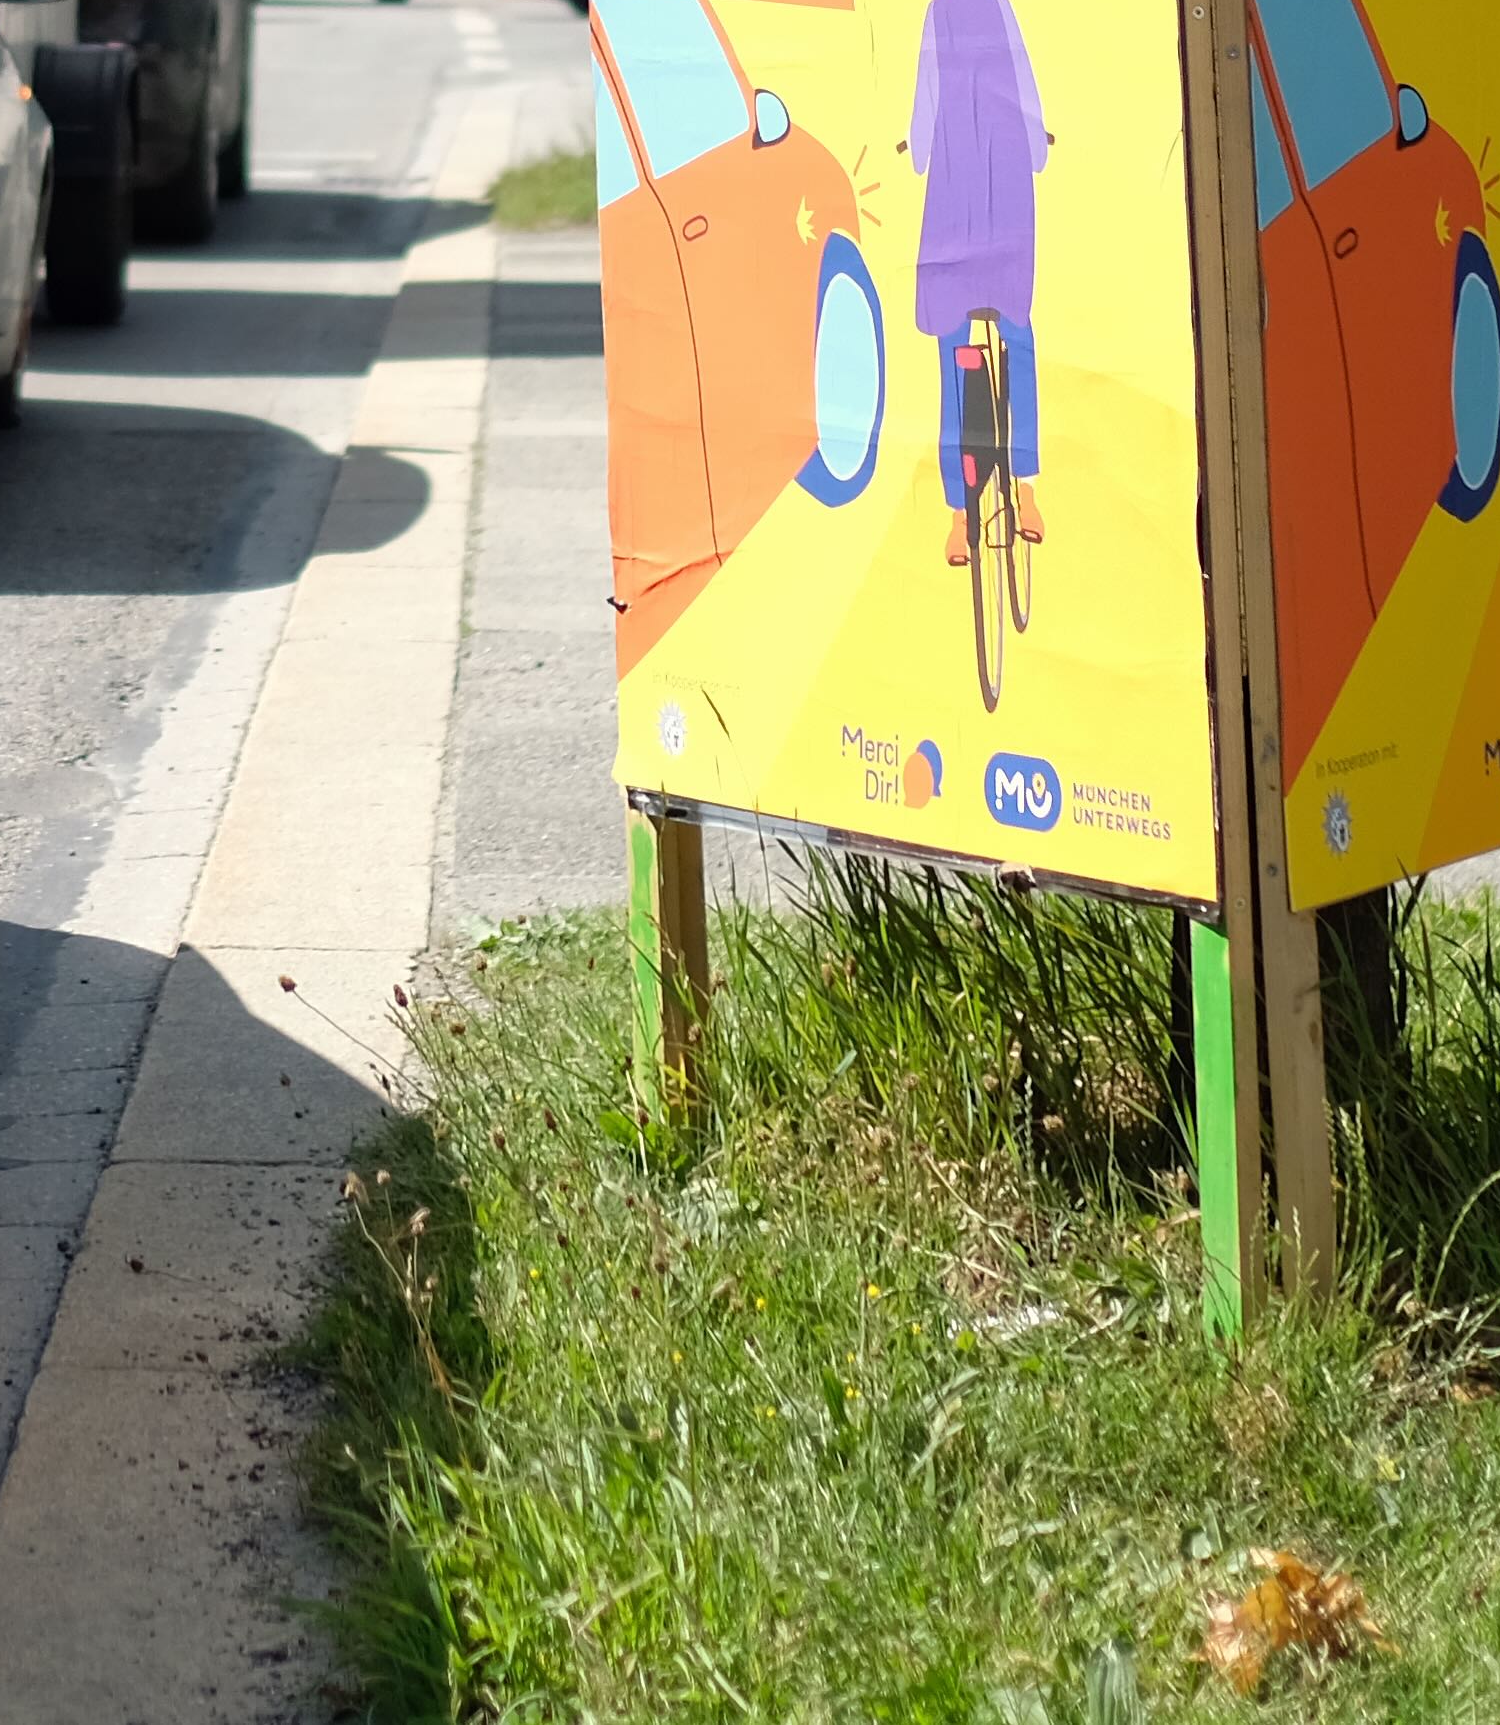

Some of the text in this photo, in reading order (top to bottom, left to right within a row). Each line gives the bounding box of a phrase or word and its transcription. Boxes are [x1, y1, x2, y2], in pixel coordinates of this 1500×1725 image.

[842, 724, 900, 768] Merci
[865, 769, 900, 806] Dir!
[1072, 781, 1151, 812] MÜNCHEN
[1072, 809, 1172, 841] UNTERWEGS
